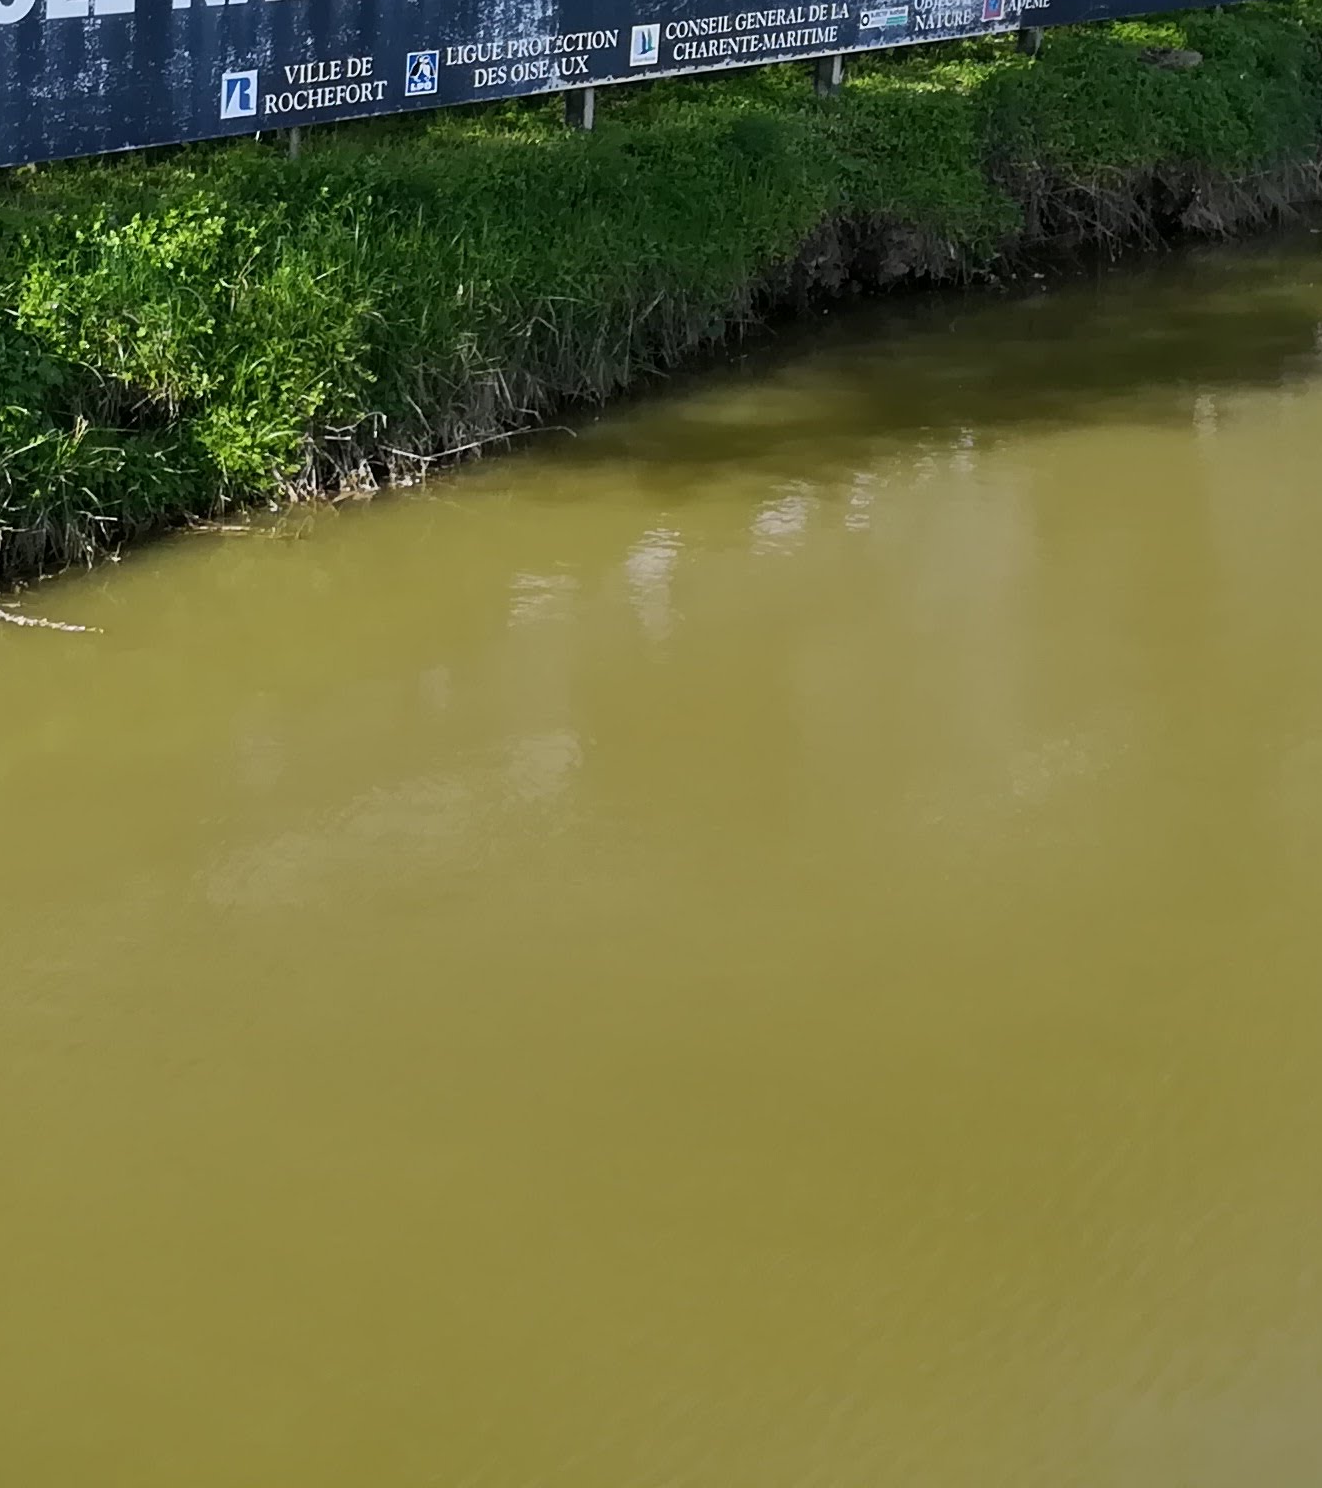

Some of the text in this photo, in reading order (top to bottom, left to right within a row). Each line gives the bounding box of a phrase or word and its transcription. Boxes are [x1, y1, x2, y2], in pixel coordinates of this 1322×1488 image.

[665, 17, 732, 40] CONSEIL
[735, 7, 805, 31] GENERAL
[808, 3, 828, 22] DE
[831, 2, 849, 20] LA
[914, 8, 973, 31] NATURE
[445, 29, 619, 66] LIGUE PROTECTION
[673, 25, 839, 60] CHARENTE-MARITIME
[284, 57, 373, 84] VILLE DE
[410, 81, 432, 92] LPO
[473, 55, 590, 88] DES OISEAUX
[264, 80, 388, 115] ROCHEFORT
